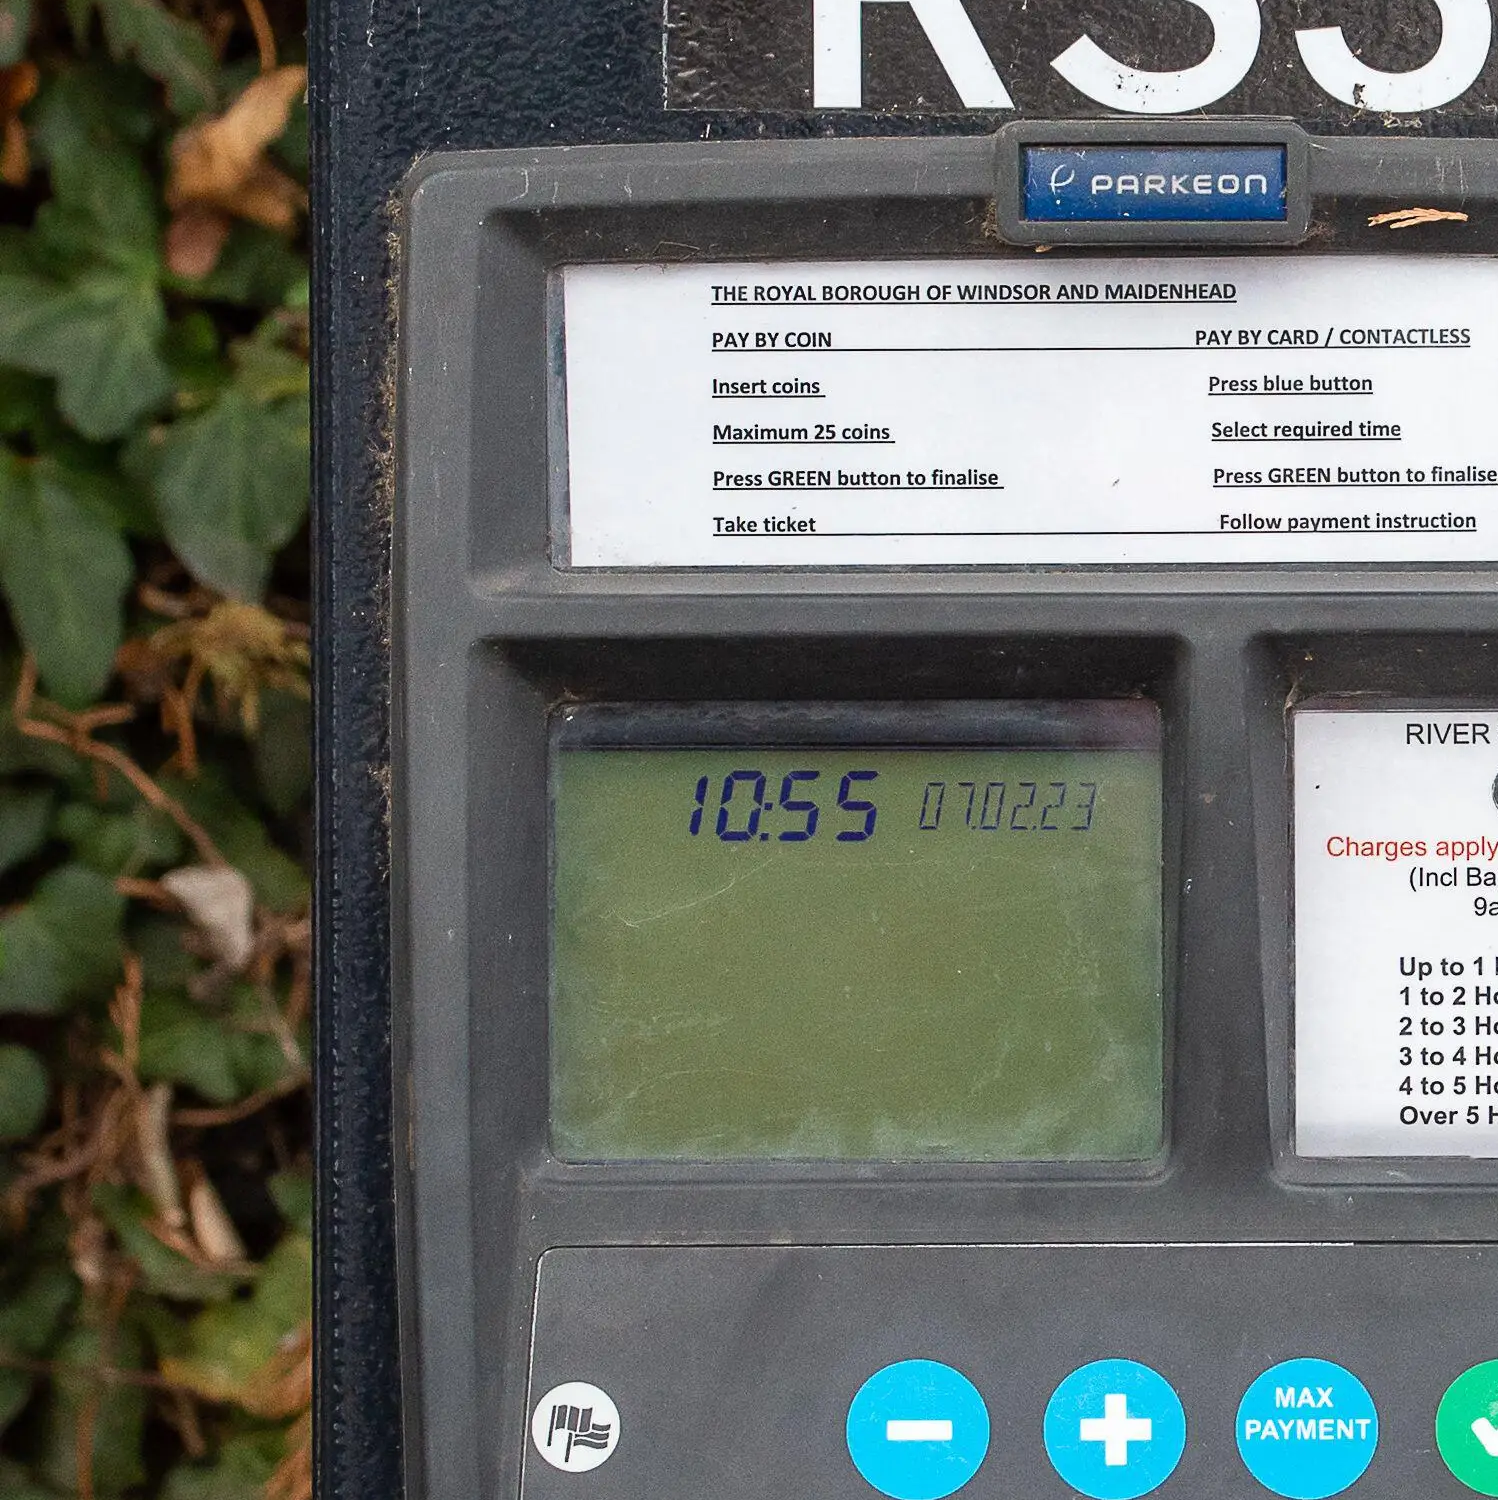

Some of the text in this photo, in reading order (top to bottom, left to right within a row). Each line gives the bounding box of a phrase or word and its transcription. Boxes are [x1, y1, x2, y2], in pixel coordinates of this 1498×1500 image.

[1091, 174, 1268, 194] PARKEON
[710, 283, 1237, 302] THE ROYAL BOROUGH OF WINDSOR AND MAIDENHEAD
[712, 331, 832, 348] PAY BY COIN
[1195, 327, 1471, 348] PAY BY CARD / CONTACTLESS
[712, 377, 820, 395] Insert coins
[1209, 374, 1373, 392] Press blue button
[713, 423, 890, 441] Maximum 25 coins
[1211, 420, 1401, 441] Select required time
[713, 468, 999, 487] Press GREEN button to finalise
[1213, 465, 1498, 484] Press GREEN button to finalise
[712, 515, 817, 533] Take ticket
[1220, 512, 1476, 534] Follow payment instruction
[1406, 722, 1491, 745] RIVER
[1326, 836, 1427, 862] Charges
[1409, 866, 1458, 892] (Incl
[1399, 956, 1433, 982] Up
[1439, 958, 1465, 977] to
[1473, 956, 1483, 976] 1
[1399, 986, 1410, 1006] 1
[1419, 987, 1445, 1006] to
[1452, 986, 1466, 1006] 2
[1399, 1016, 1413, 1036] 2
[1420, 1017, 1445, 1036] to
[1452, 1015, 1466, 1036] 3
[1399, 1046, 1413, 1066] 3
[1420, 1047, 1445, 1066] to
[1452, 1045, 1467, 1066] 4
[1398, 1075, 1414, 1096] 4
[1420, 1076, 1445, 1096] to
[1453, 1075, 1467, 1095] 5
[1399, 1105, 1459, 1126] Over
[1466, 1105, 1480, 1125] 5
[1275, 1386, 1334, 1409] MAX
[1245, 1418, 1372, 1441] PAYMENT
